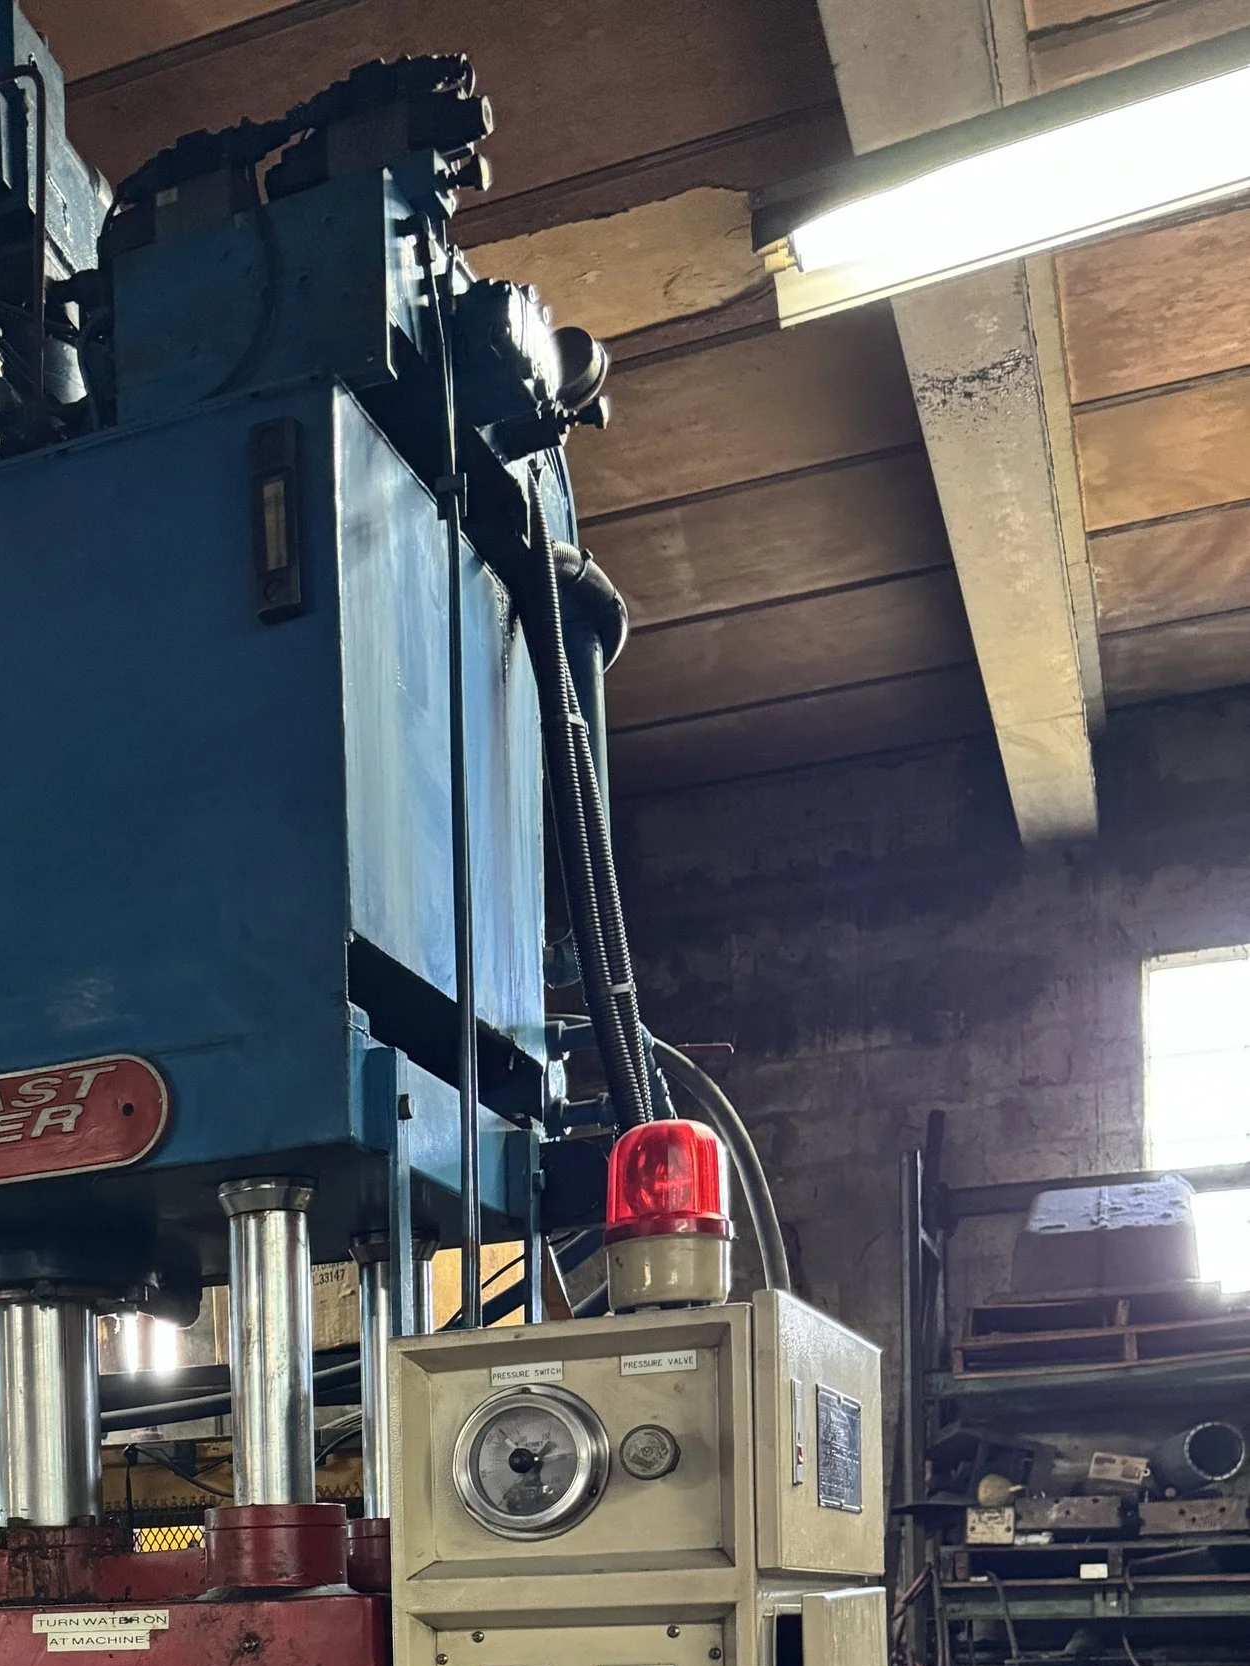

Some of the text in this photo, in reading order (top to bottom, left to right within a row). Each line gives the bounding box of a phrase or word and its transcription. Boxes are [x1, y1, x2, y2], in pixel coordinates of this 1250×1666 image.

[623, 1356, 694, 1369] PRESSURE VALVE
[492, 1367, 562, 1380] PRESSURE SWITCH
[36, 1618, 79, 1627] TURN
[143, 1615, 167, 1624] ON
[49, 1635, 146, 1646] AT MACHINE
